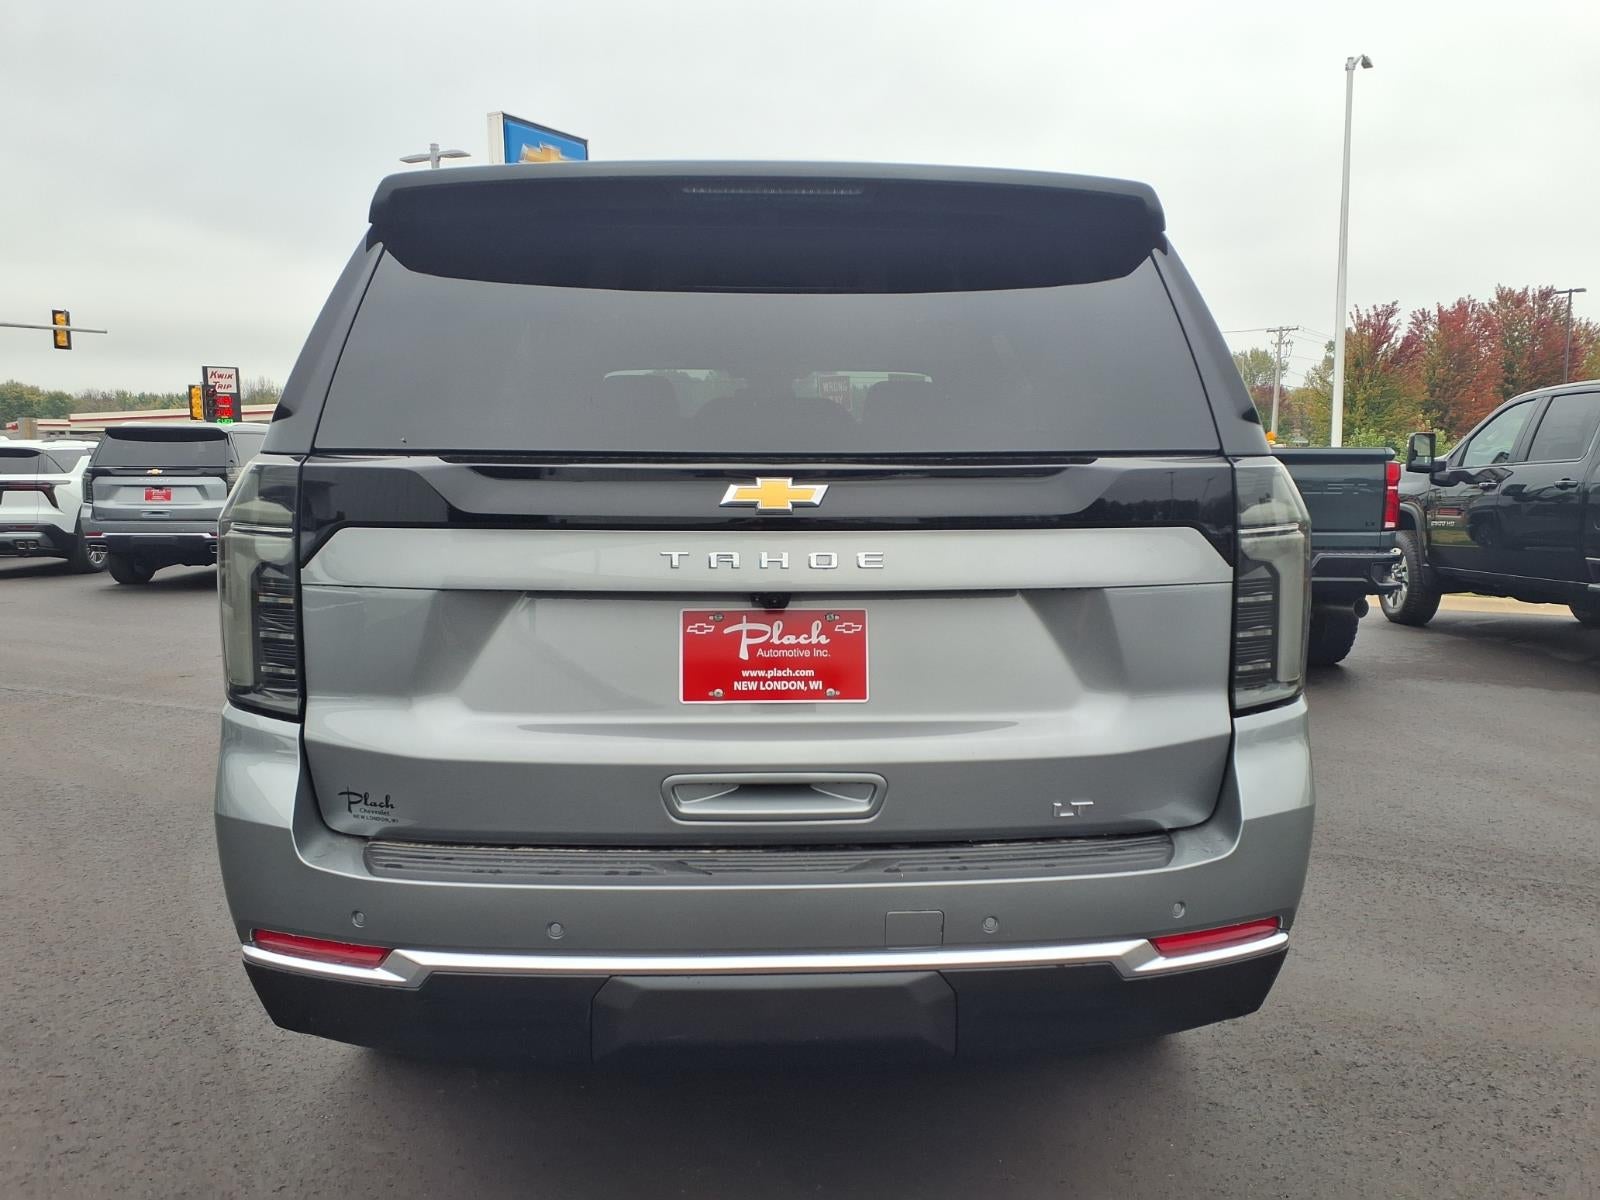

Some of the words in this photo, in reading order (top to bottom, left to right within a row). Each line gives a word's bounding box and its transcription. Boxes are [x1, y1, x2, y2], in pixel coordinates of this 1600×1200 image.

[660, 552, 885, 569] TAHOE
[723, 615, 830, 660] Plach
[756, 648, 811, 658] Automotive
[813, 648, 831, 657] Inc.
[741, 667, 815, 678] www.plach.com
[733, 680, 757, 691] NEW
[759, 680, 807, 692] LONDON,
[809, 680, 823, 690] WI
[338, 785, 395, 813] Plach
[1052, 801, 1094, 817] LT
